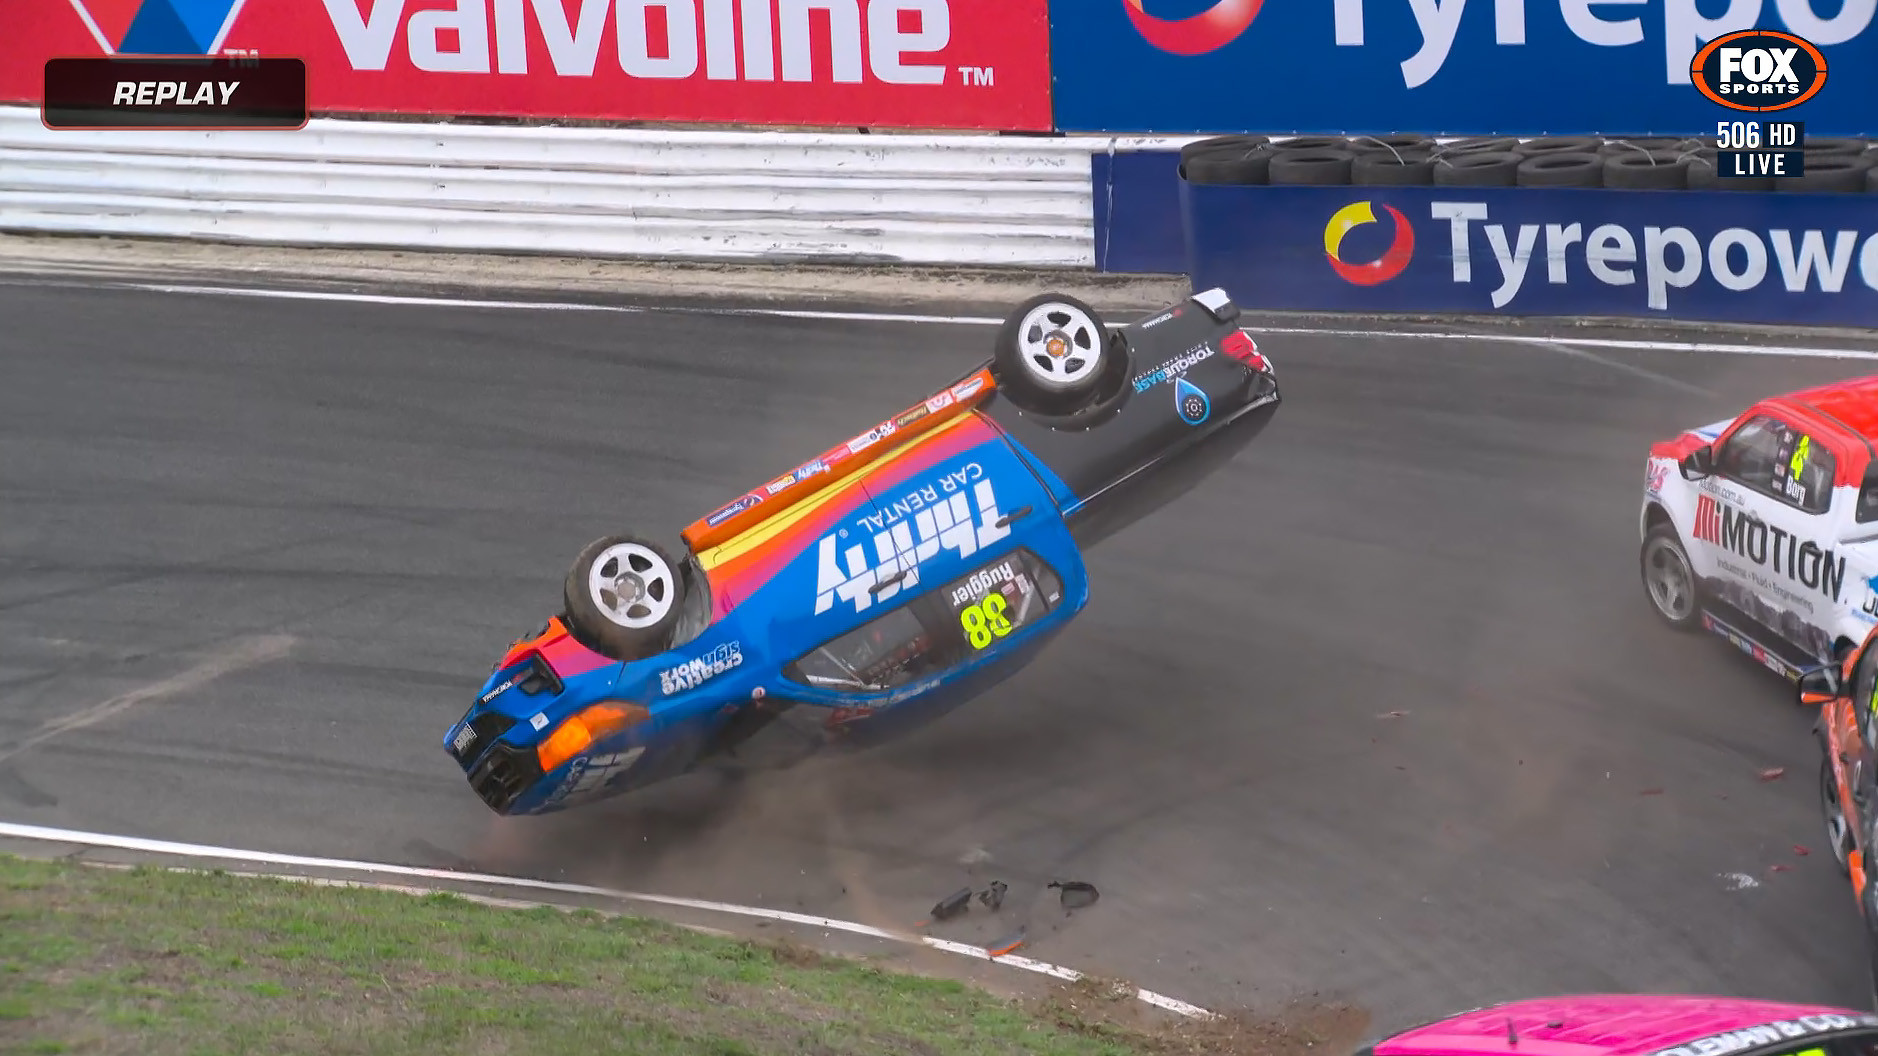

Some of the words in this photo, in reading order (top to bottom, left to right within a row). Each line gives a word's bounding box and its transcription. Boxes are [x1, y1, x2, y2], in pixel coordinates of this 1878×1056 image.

[943, 463, 983, 494] CAR
[857, 486, 938, 531] RENTAL
[814, 478, 1012, 615] Thrifty
[951, 560, 1013, 607] Ruggier
